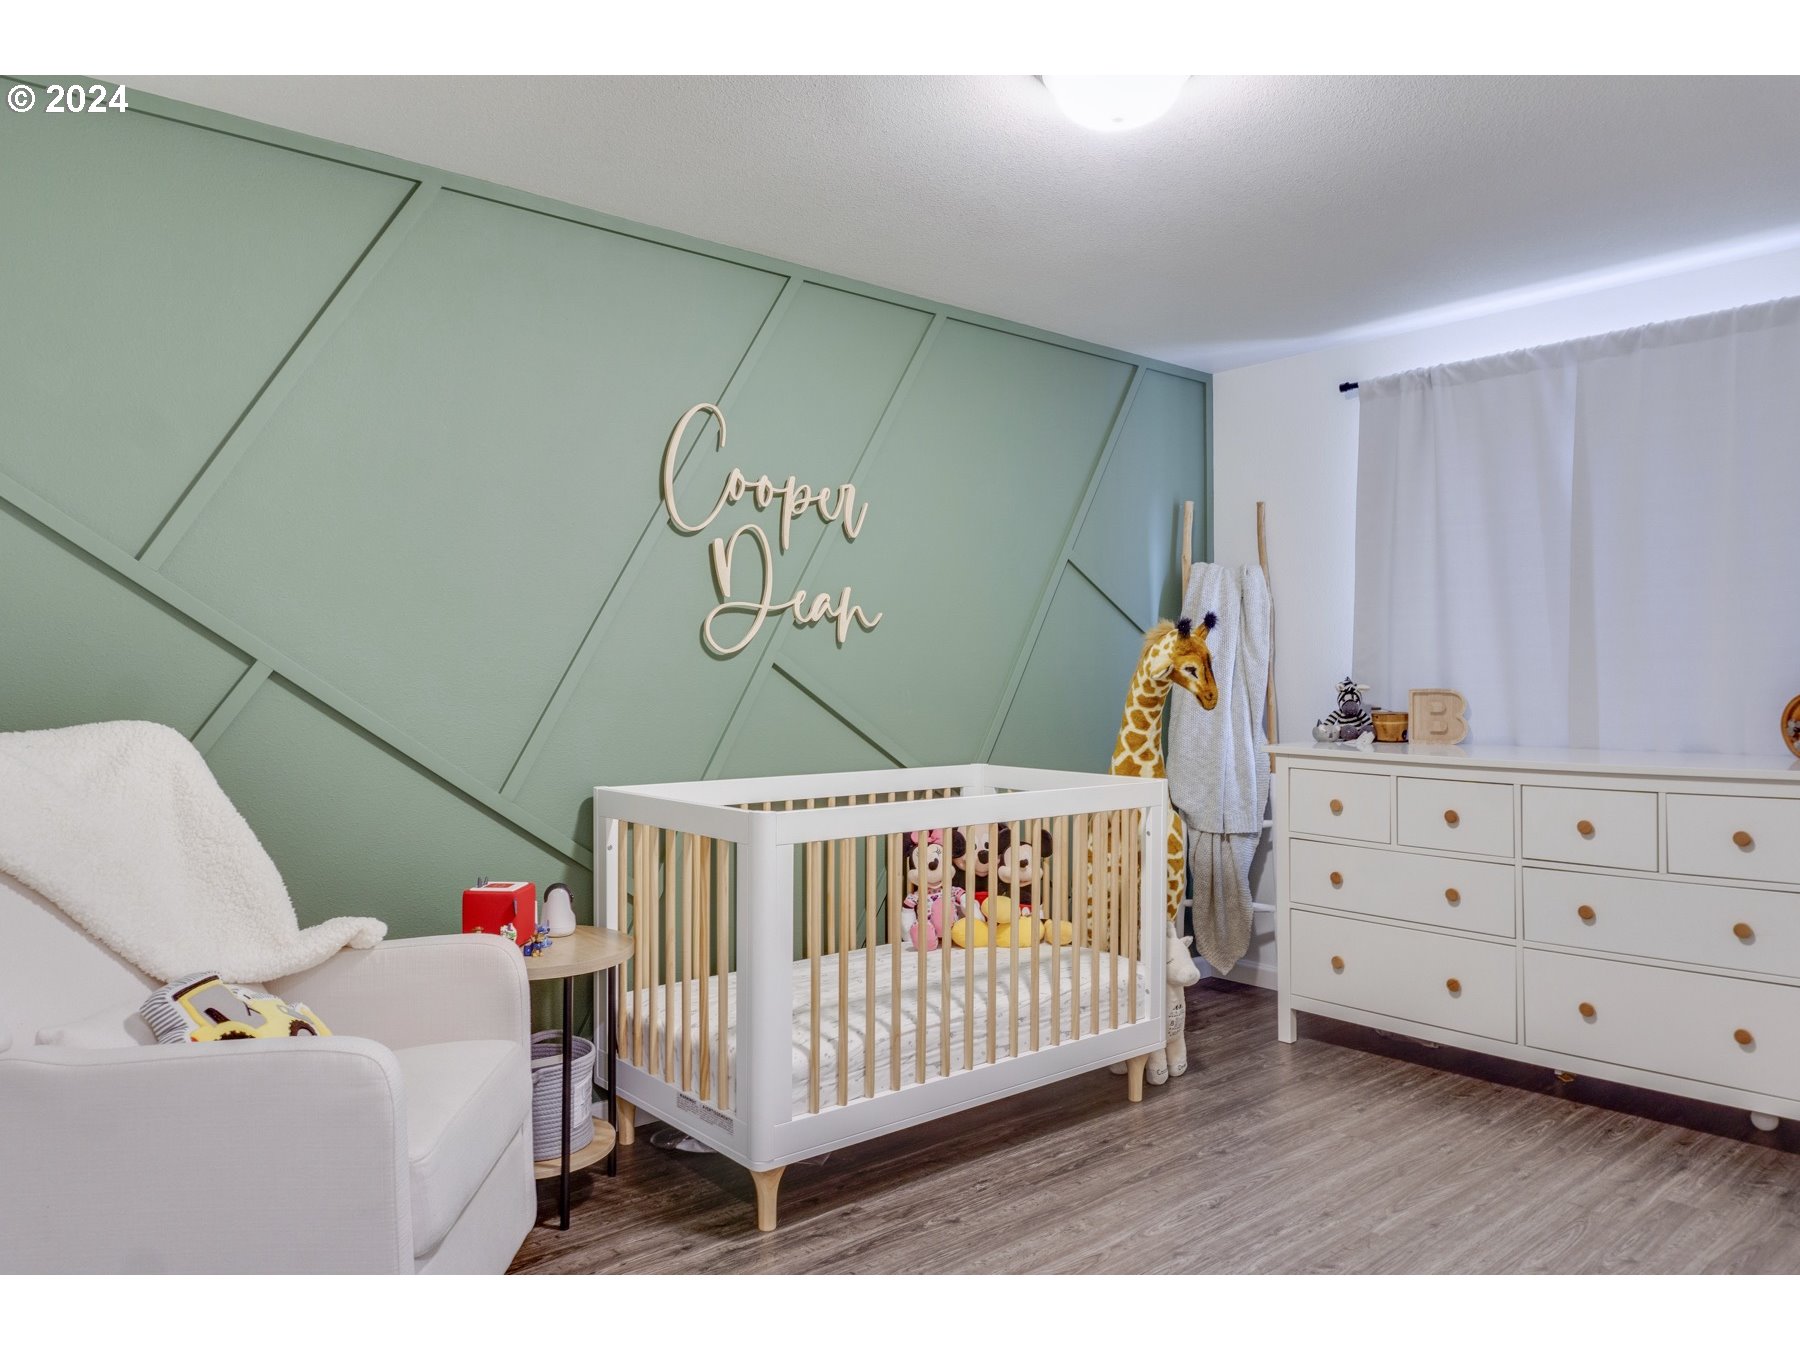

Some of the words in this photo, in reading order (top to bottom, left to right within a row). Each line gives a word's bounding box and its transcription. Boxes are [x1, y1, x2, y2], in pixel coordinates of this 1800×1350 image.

[662, 402, 869, 551] Cooper
[702, 523, 884, 655] Dean
[1408, 688, 1469, 745] B
